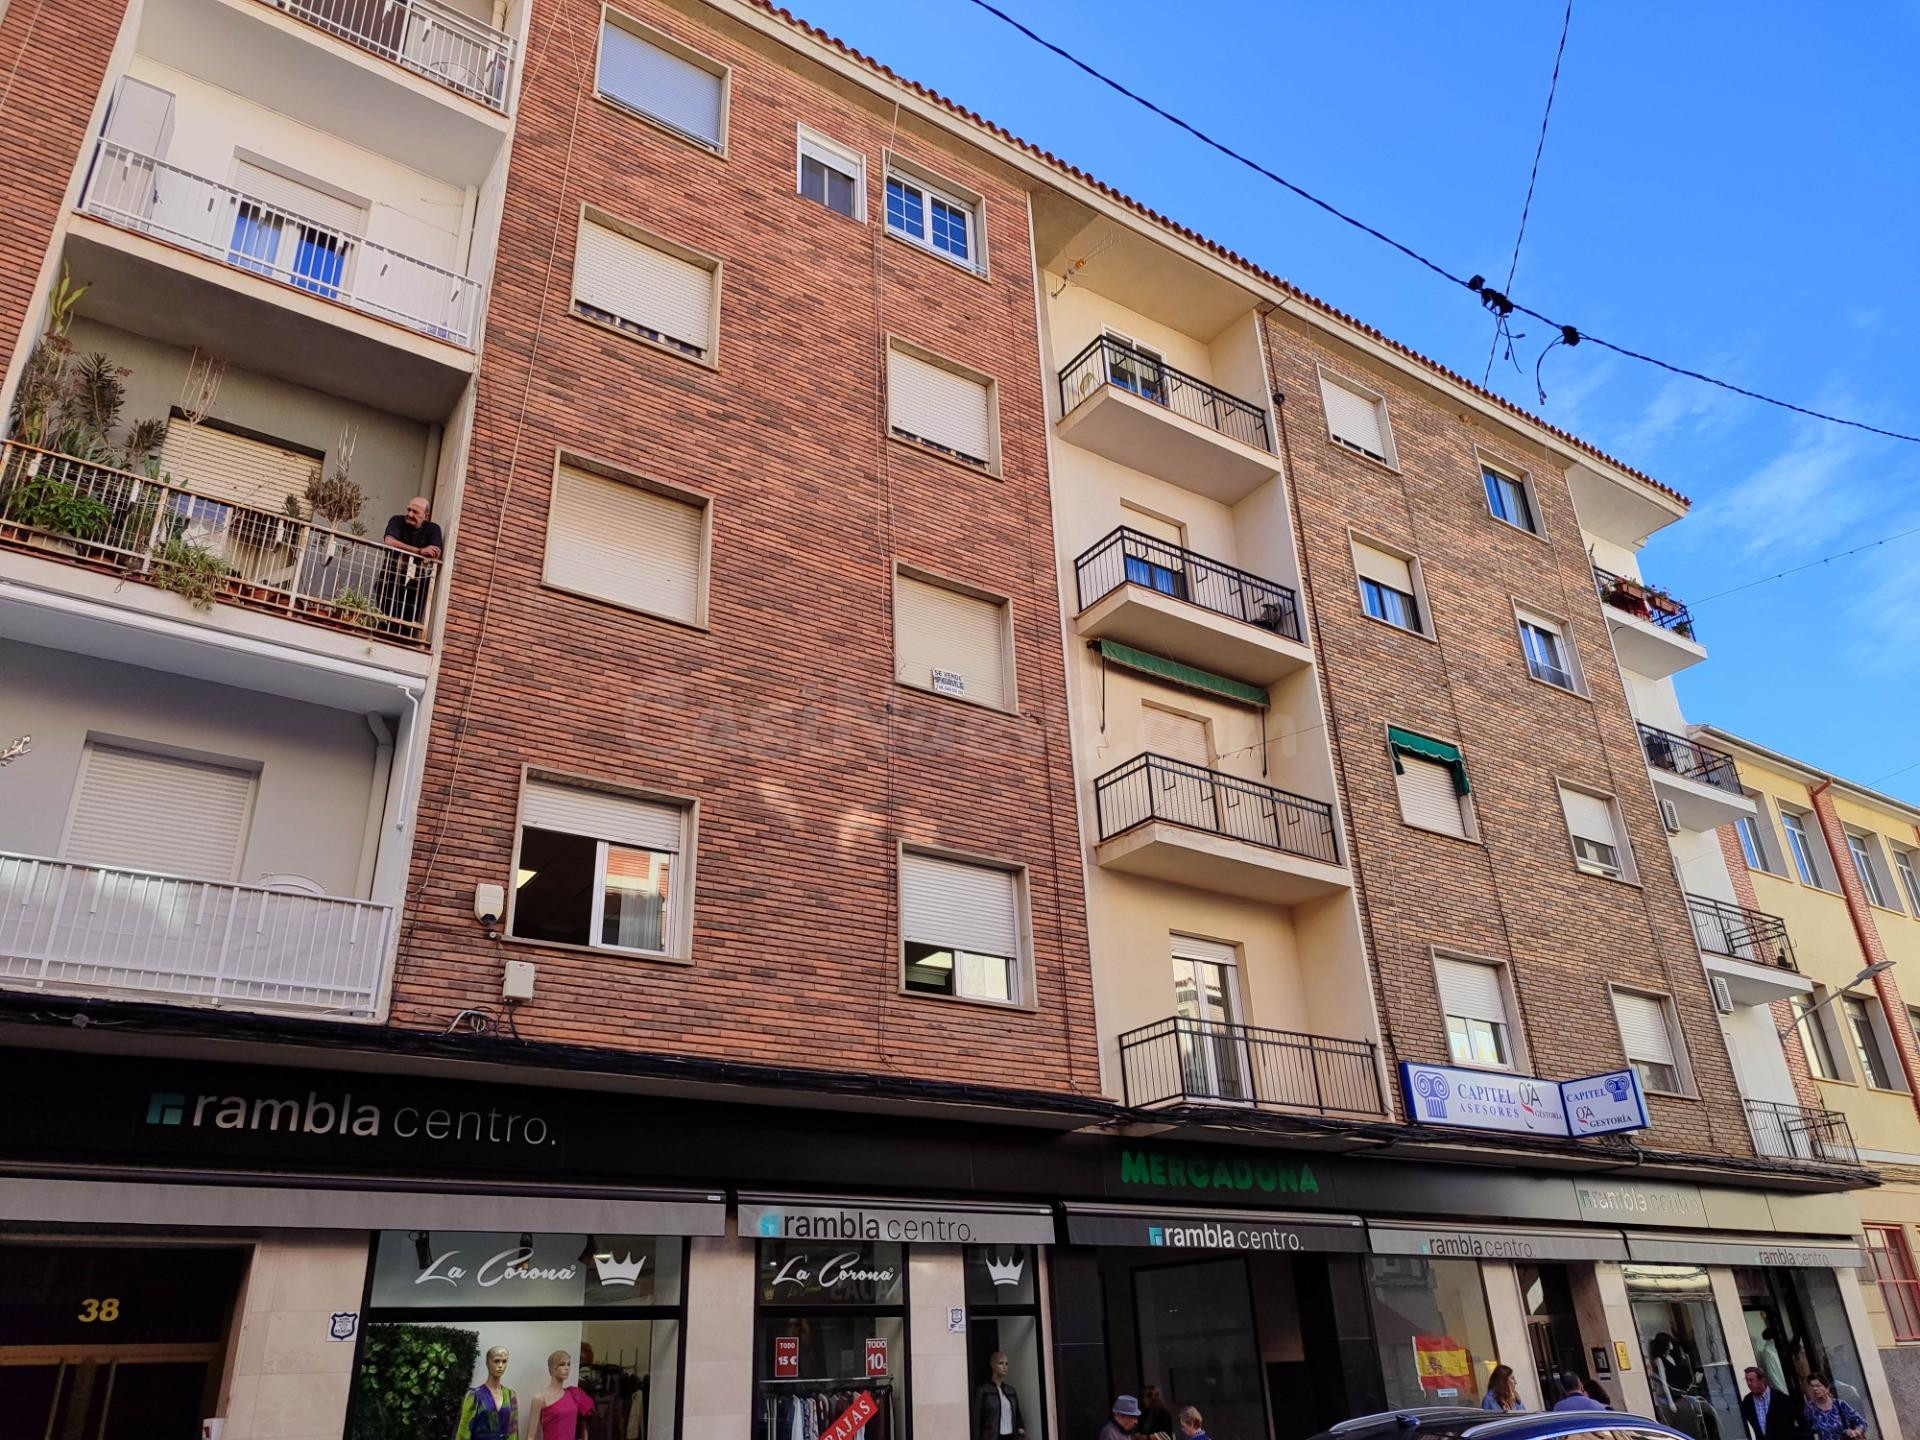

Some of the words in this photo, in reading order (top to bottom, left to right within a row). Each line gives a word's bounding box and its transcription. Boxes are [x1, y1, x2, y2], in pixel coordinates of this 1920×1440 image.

[1457, 1084, 1516, 1105] CAPITEL
[1566, 1089, 1608, 1103] CAPITEL
[192, 1091, 380, 1136] rambla
[393, 1105, 557, 1145] centro.
[1459, 1103, 1520, 1119] ASESORES
[1589, 1112, 1633, 1128] GESTORÍA
[1120, 1150, 1320, 1194] MERCADONA
[784, 1211, 881, 1239] rambla
[886, 1217, 978, 1242] centro.
[1164, 1224, 1235, 1247] rambla
[1237, 1228, 1305, 1250] centro.
[1429, 1234, 1484, 1256] rambla
[1759, 1248, 1796, 1265] rambla
[415, 1250, 466, 1288] La
[771, 1255, 811, 1288] La
[77, 1297, 119, 1323] 38
[867, 1340, 887, 1349] TODO
